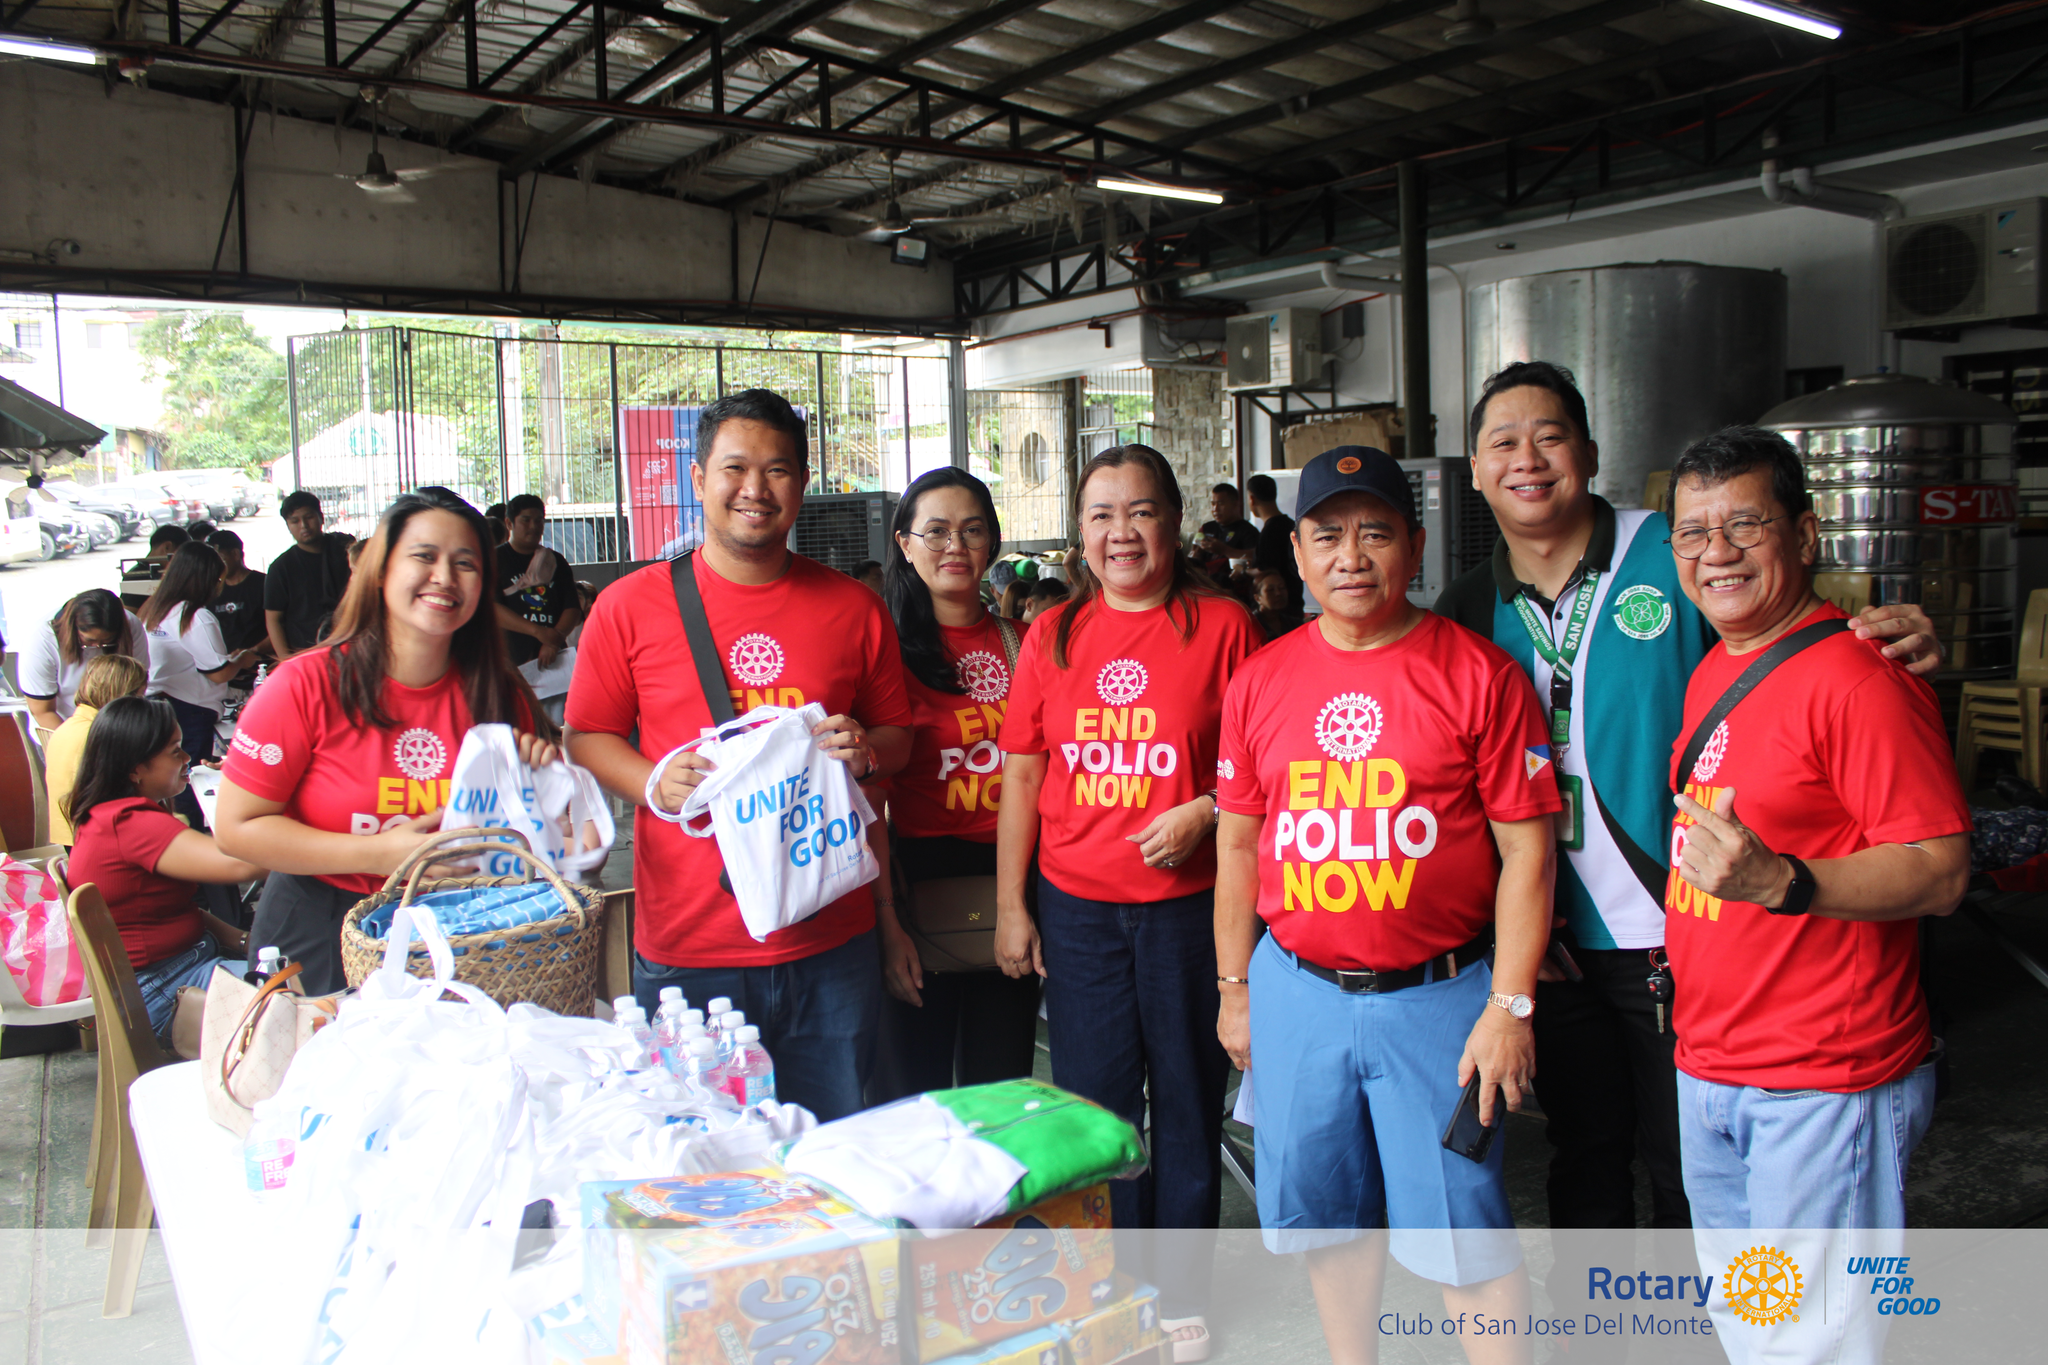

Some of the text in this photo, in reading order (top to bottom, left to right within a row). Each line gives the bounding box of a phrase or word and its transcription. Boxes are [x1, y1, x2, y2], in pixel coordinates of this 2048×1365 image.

[523, 613, 553, 624] ADE
[1574, 584, 1595, 620] JOSE
[1517, 598, 1553, 652] DEL MONTE SAVINGS
[1565, 622, 1584, 651] SAN
[1336, 699, 1368, 709] ROTARY
[954, 700, 1007, 745] EN
[1075, 708, 1156, 741] END
[1061, 741, 1177, 777] POLIO
[1324, 734, 1374, 756] INTERNATIONAL
[454, 787, 534, 814] UNIE
[735, 766, 810, 824] UNITE
[946, 774, 1002, 811] NO
[1075, 774, 1152, 808] NOW
[1289, 758, 1406, 810] END
[780, 794, 824, 843] FOR
[1275, 806, 1438, 862] POLIO
[790, 809, 861, 868] GOOD
[1283, 859, 1417, 912] NOW
[746, 1077, 764, 1088] RE
[263, 1158, 284, 1173] RE
[650, 1178, 784, 1220] BIG
[761, 1178, 813, 1200] 250
[879, 1267, 896, 1286] 10
[982, 1213, 1067, 1322] BIG
[824, 1272, 861, 1337] 250
[846, 1254, 874, 1335] pineapple drink
[884, 1303, 897, 1320] ml
[922, 1290, 937, 1308] ml
[961, 1266, 994, 1326] 250
[739, 1275, 837, 1365] BIG
[880, 1321, 898, 1348] 250
[924, 1321, 942, 1339] 10
[956, 1308, 973, 1339] drink
